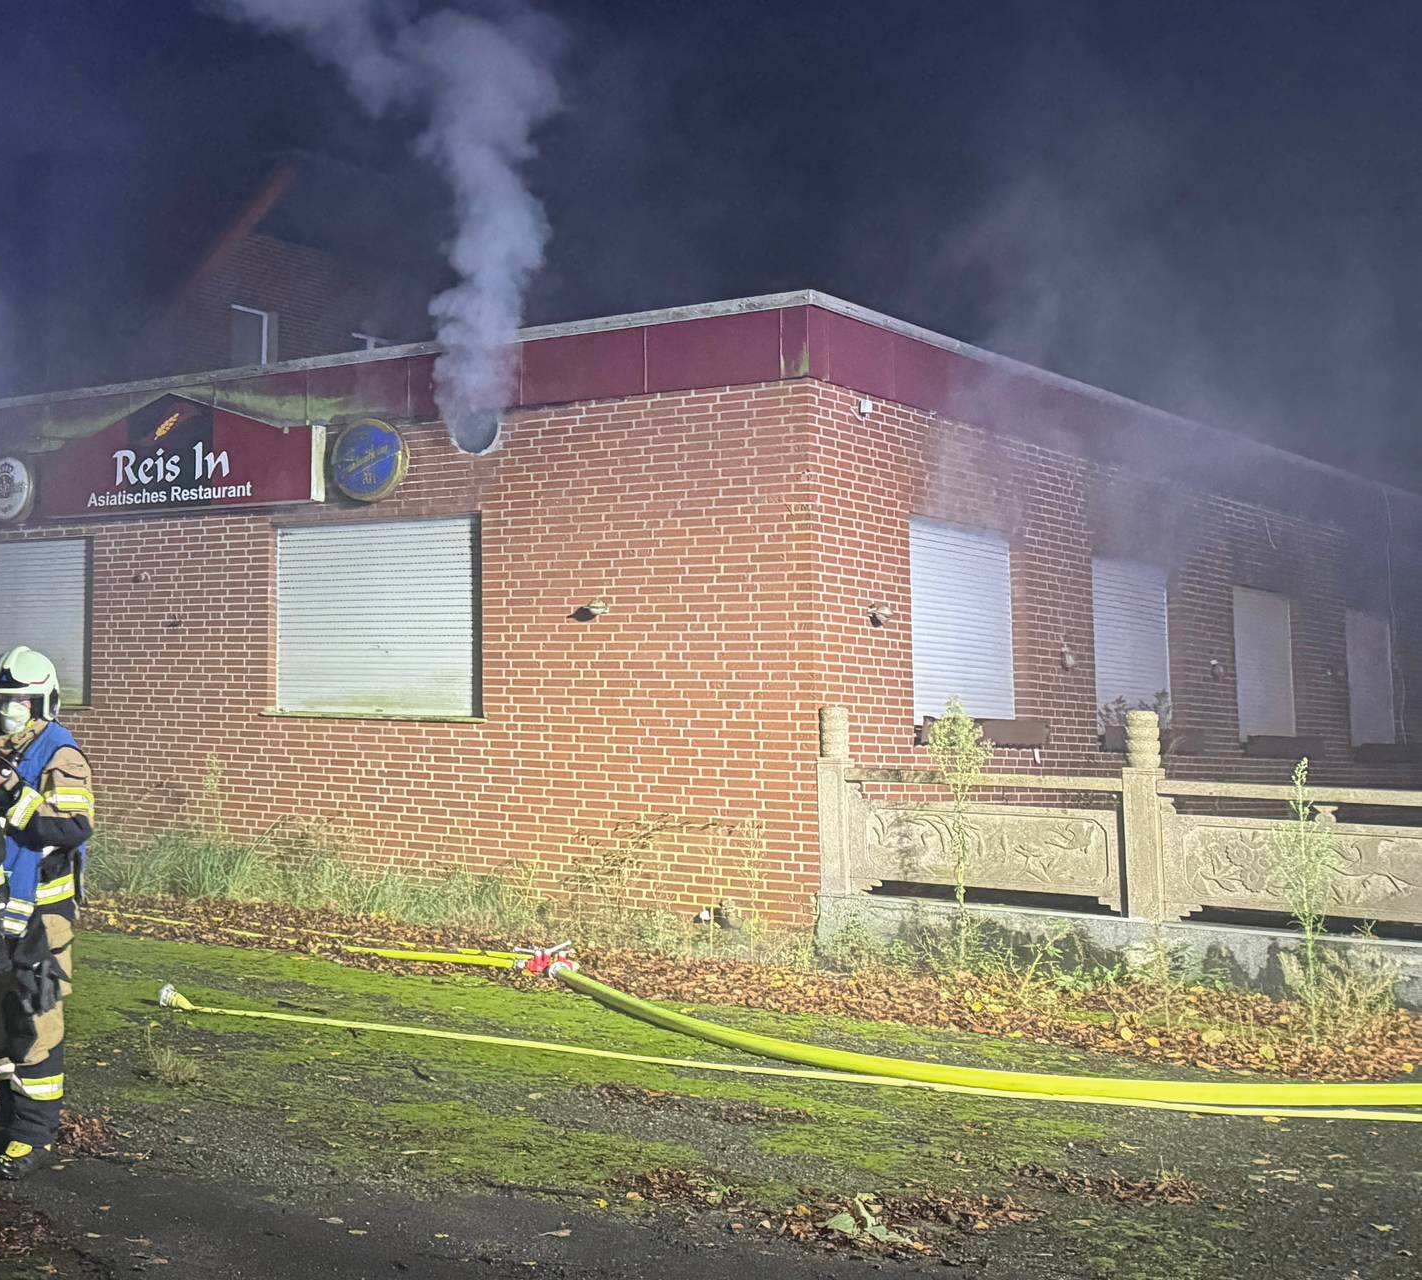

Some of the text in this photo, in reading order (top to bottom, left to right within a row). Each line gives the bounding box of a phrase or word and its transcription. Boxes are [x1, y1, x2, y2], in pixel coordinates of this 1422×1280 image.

[112, 441, 230, 486] Reis In
[87, 481, 252, 507] Asiatisches Restaurant
